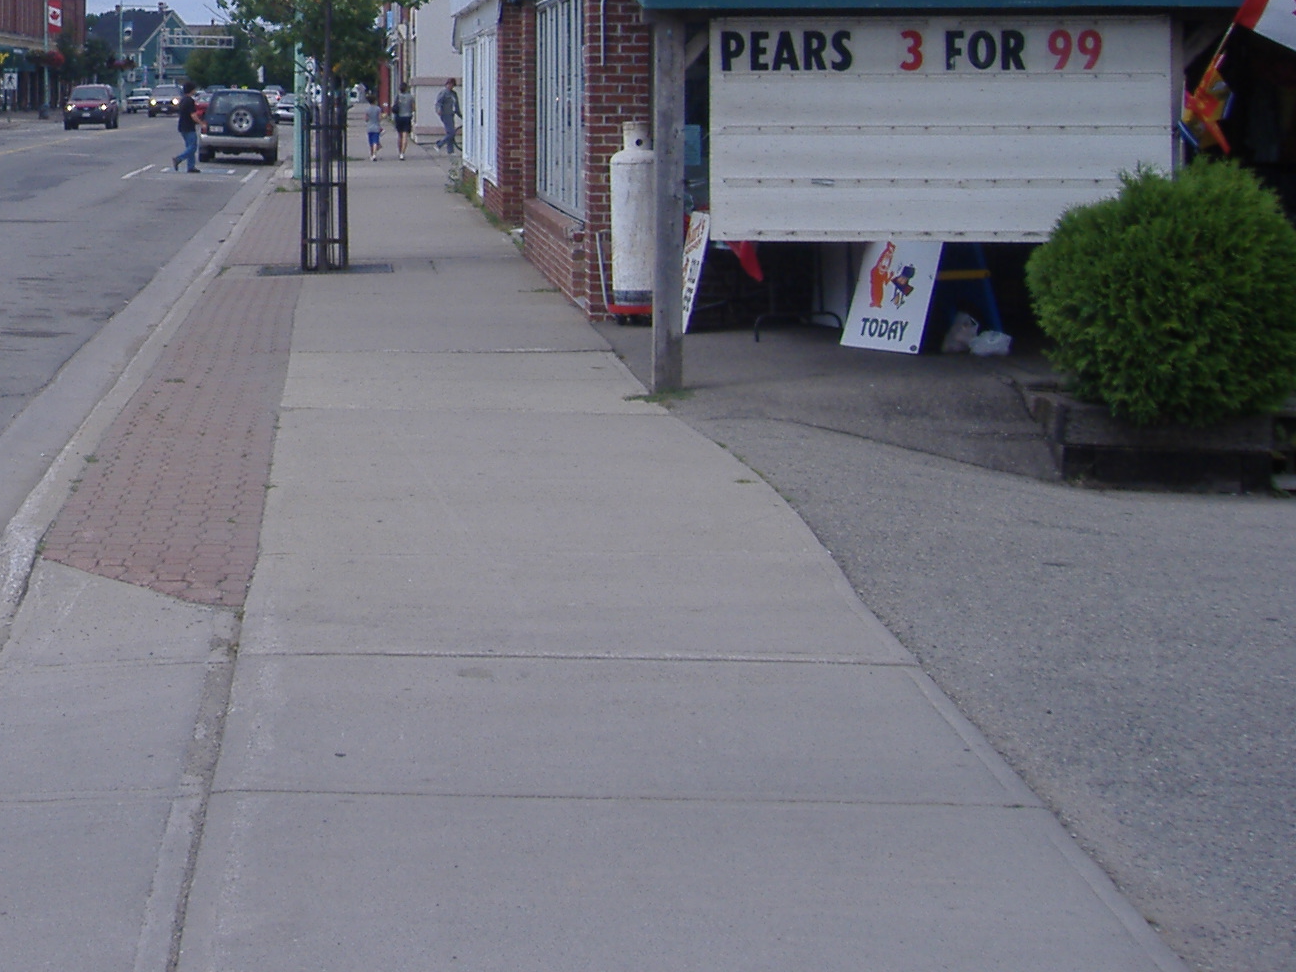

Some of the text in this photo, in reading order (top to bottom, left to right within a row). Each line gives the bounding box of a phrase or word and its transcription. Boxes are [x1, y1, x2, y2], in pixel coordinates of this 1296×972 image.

[720, 29, 1103, 72] PEARS 3 FOR 99
[860, 317, 909, 342] TODAY
